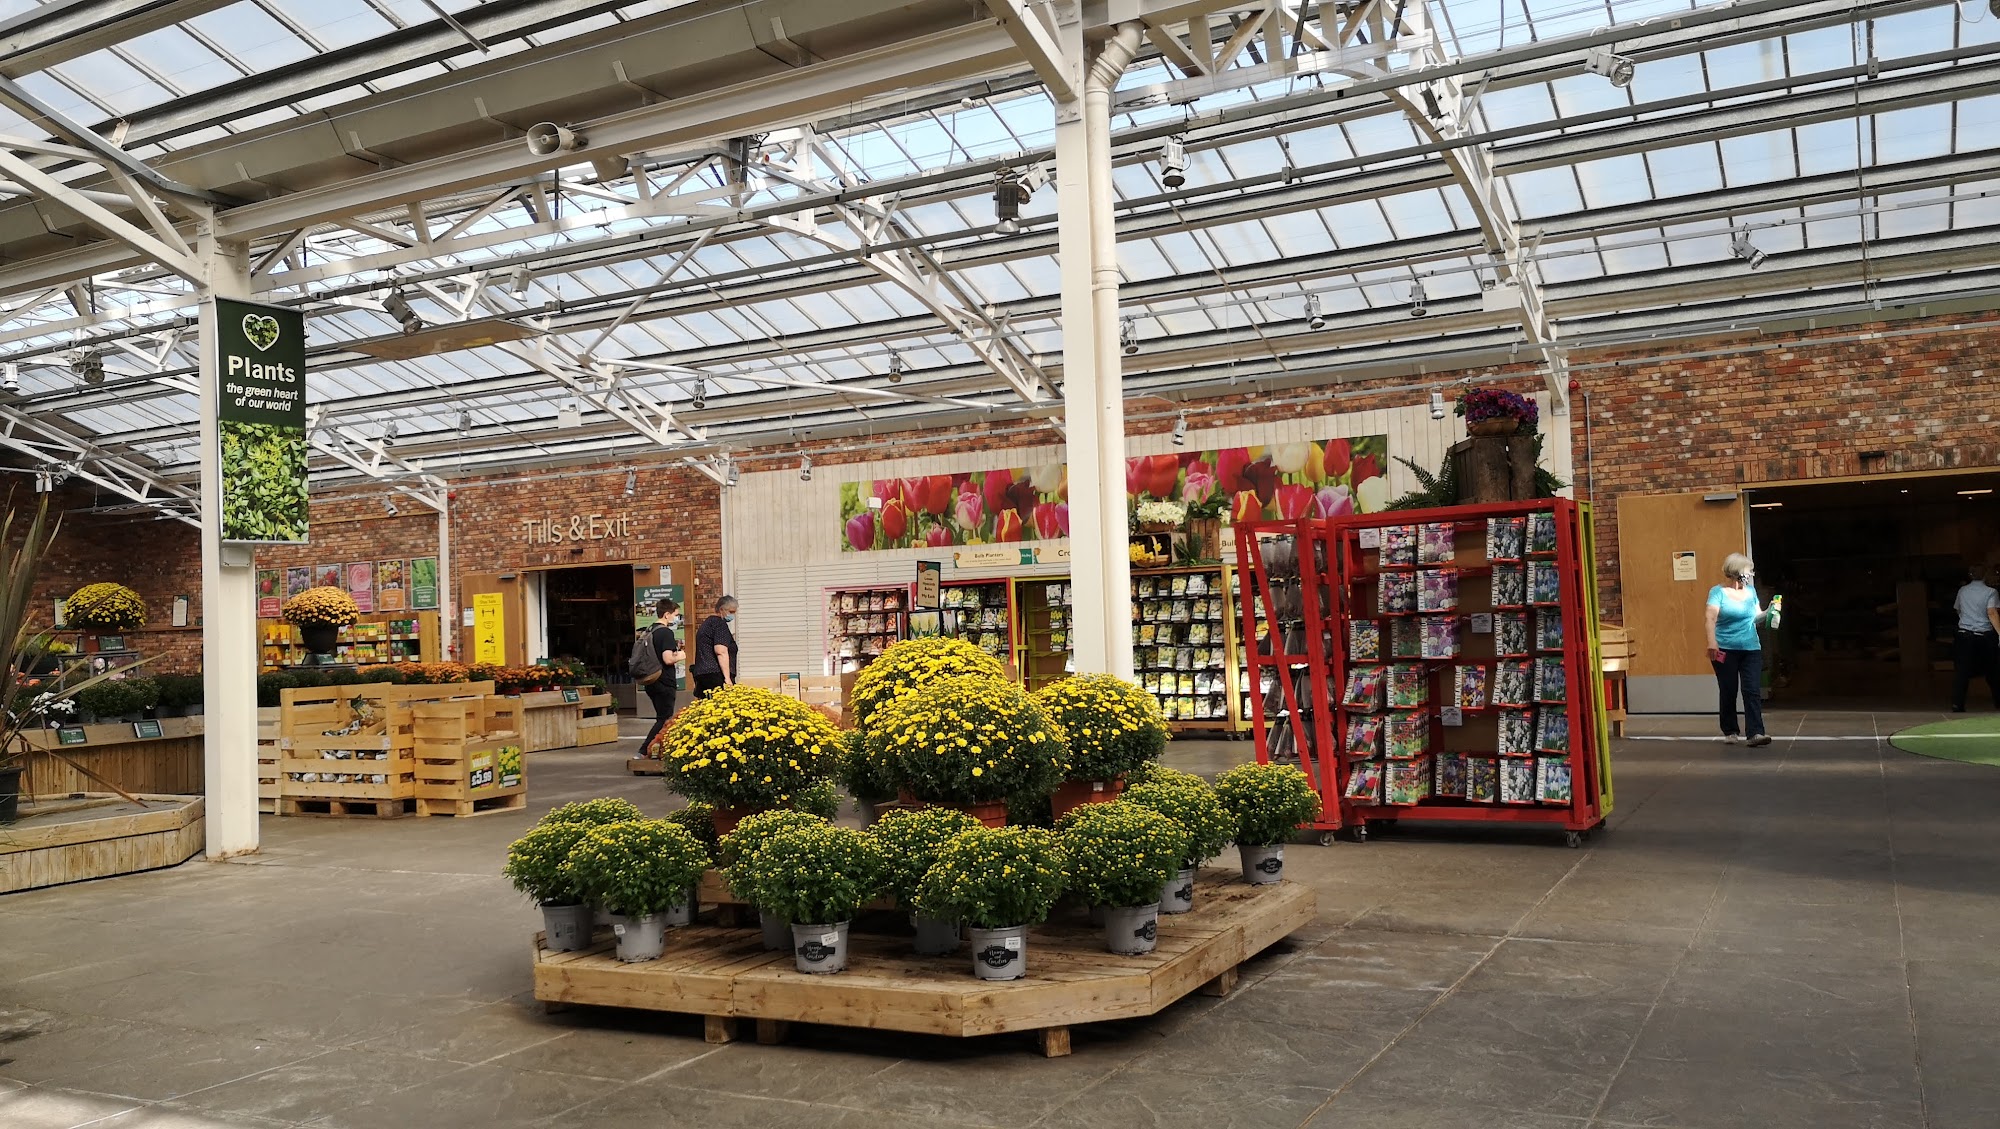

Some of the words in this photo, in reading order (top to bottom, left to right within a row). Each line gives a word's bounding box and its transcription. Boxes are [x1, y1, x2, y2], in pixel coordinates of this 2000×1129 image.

[228, 355, 296, 383] Plants
[226, 382, 243, 394] the
[245, 386, 272, 397] green
[273, 387, 298, 400] heart
[235, 396, 246, 406] of
[248, 398, 265, 409] our
[266, 400, 292, 412] world
[523, 518, 563, 544] Tills
[569, 515, 586, 541] &
[590, 512, 630, 539] Exit
[471, 770, 492, 786] £5.99
